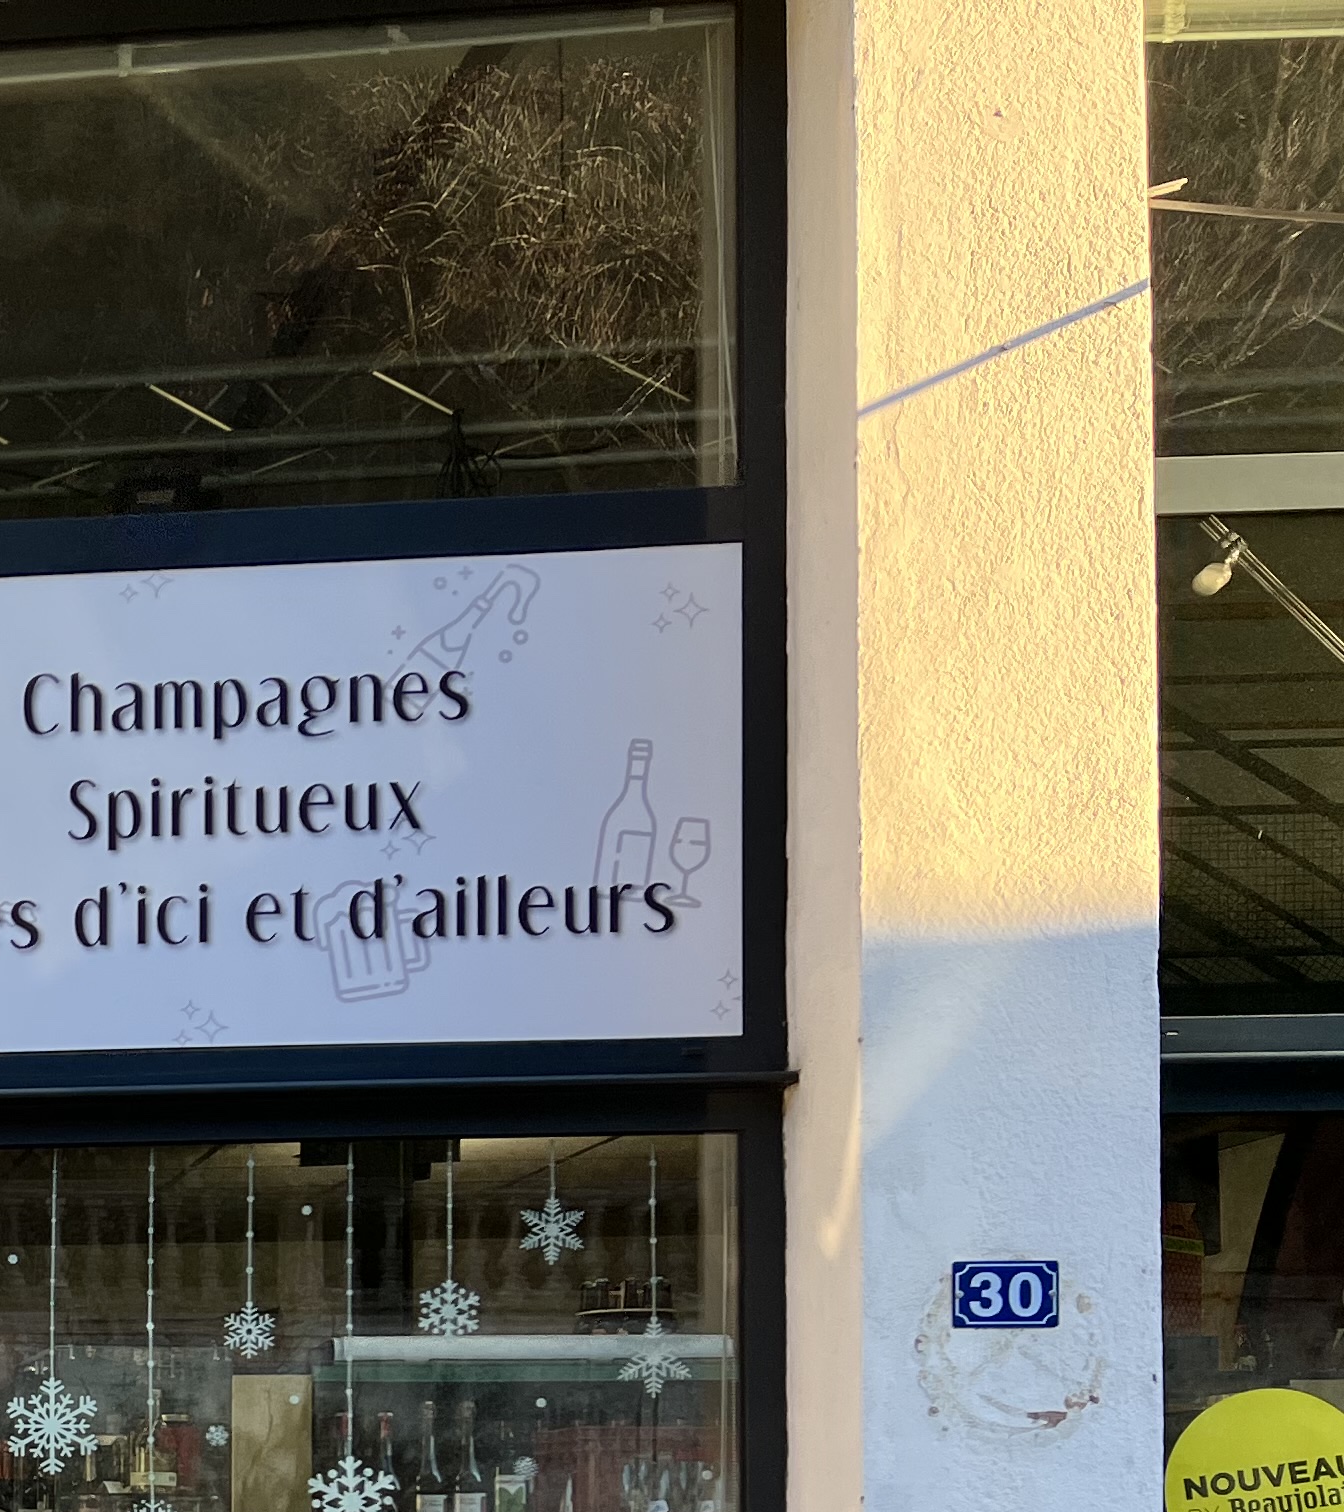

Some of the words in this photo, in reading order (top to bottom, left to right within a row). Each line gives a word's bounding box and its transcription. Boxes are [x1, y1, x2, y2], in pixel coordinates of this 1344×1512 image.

[22, 667, 472, 742] Champagnes
[67, 776, 425, 850] Spiritueux
[73, 881, 213, 948] d'ici
[244, 883, 314, 943] et
[349, 873, 678, 940] d'ailleurs
[968, 1271, 1043, 1318] 30
